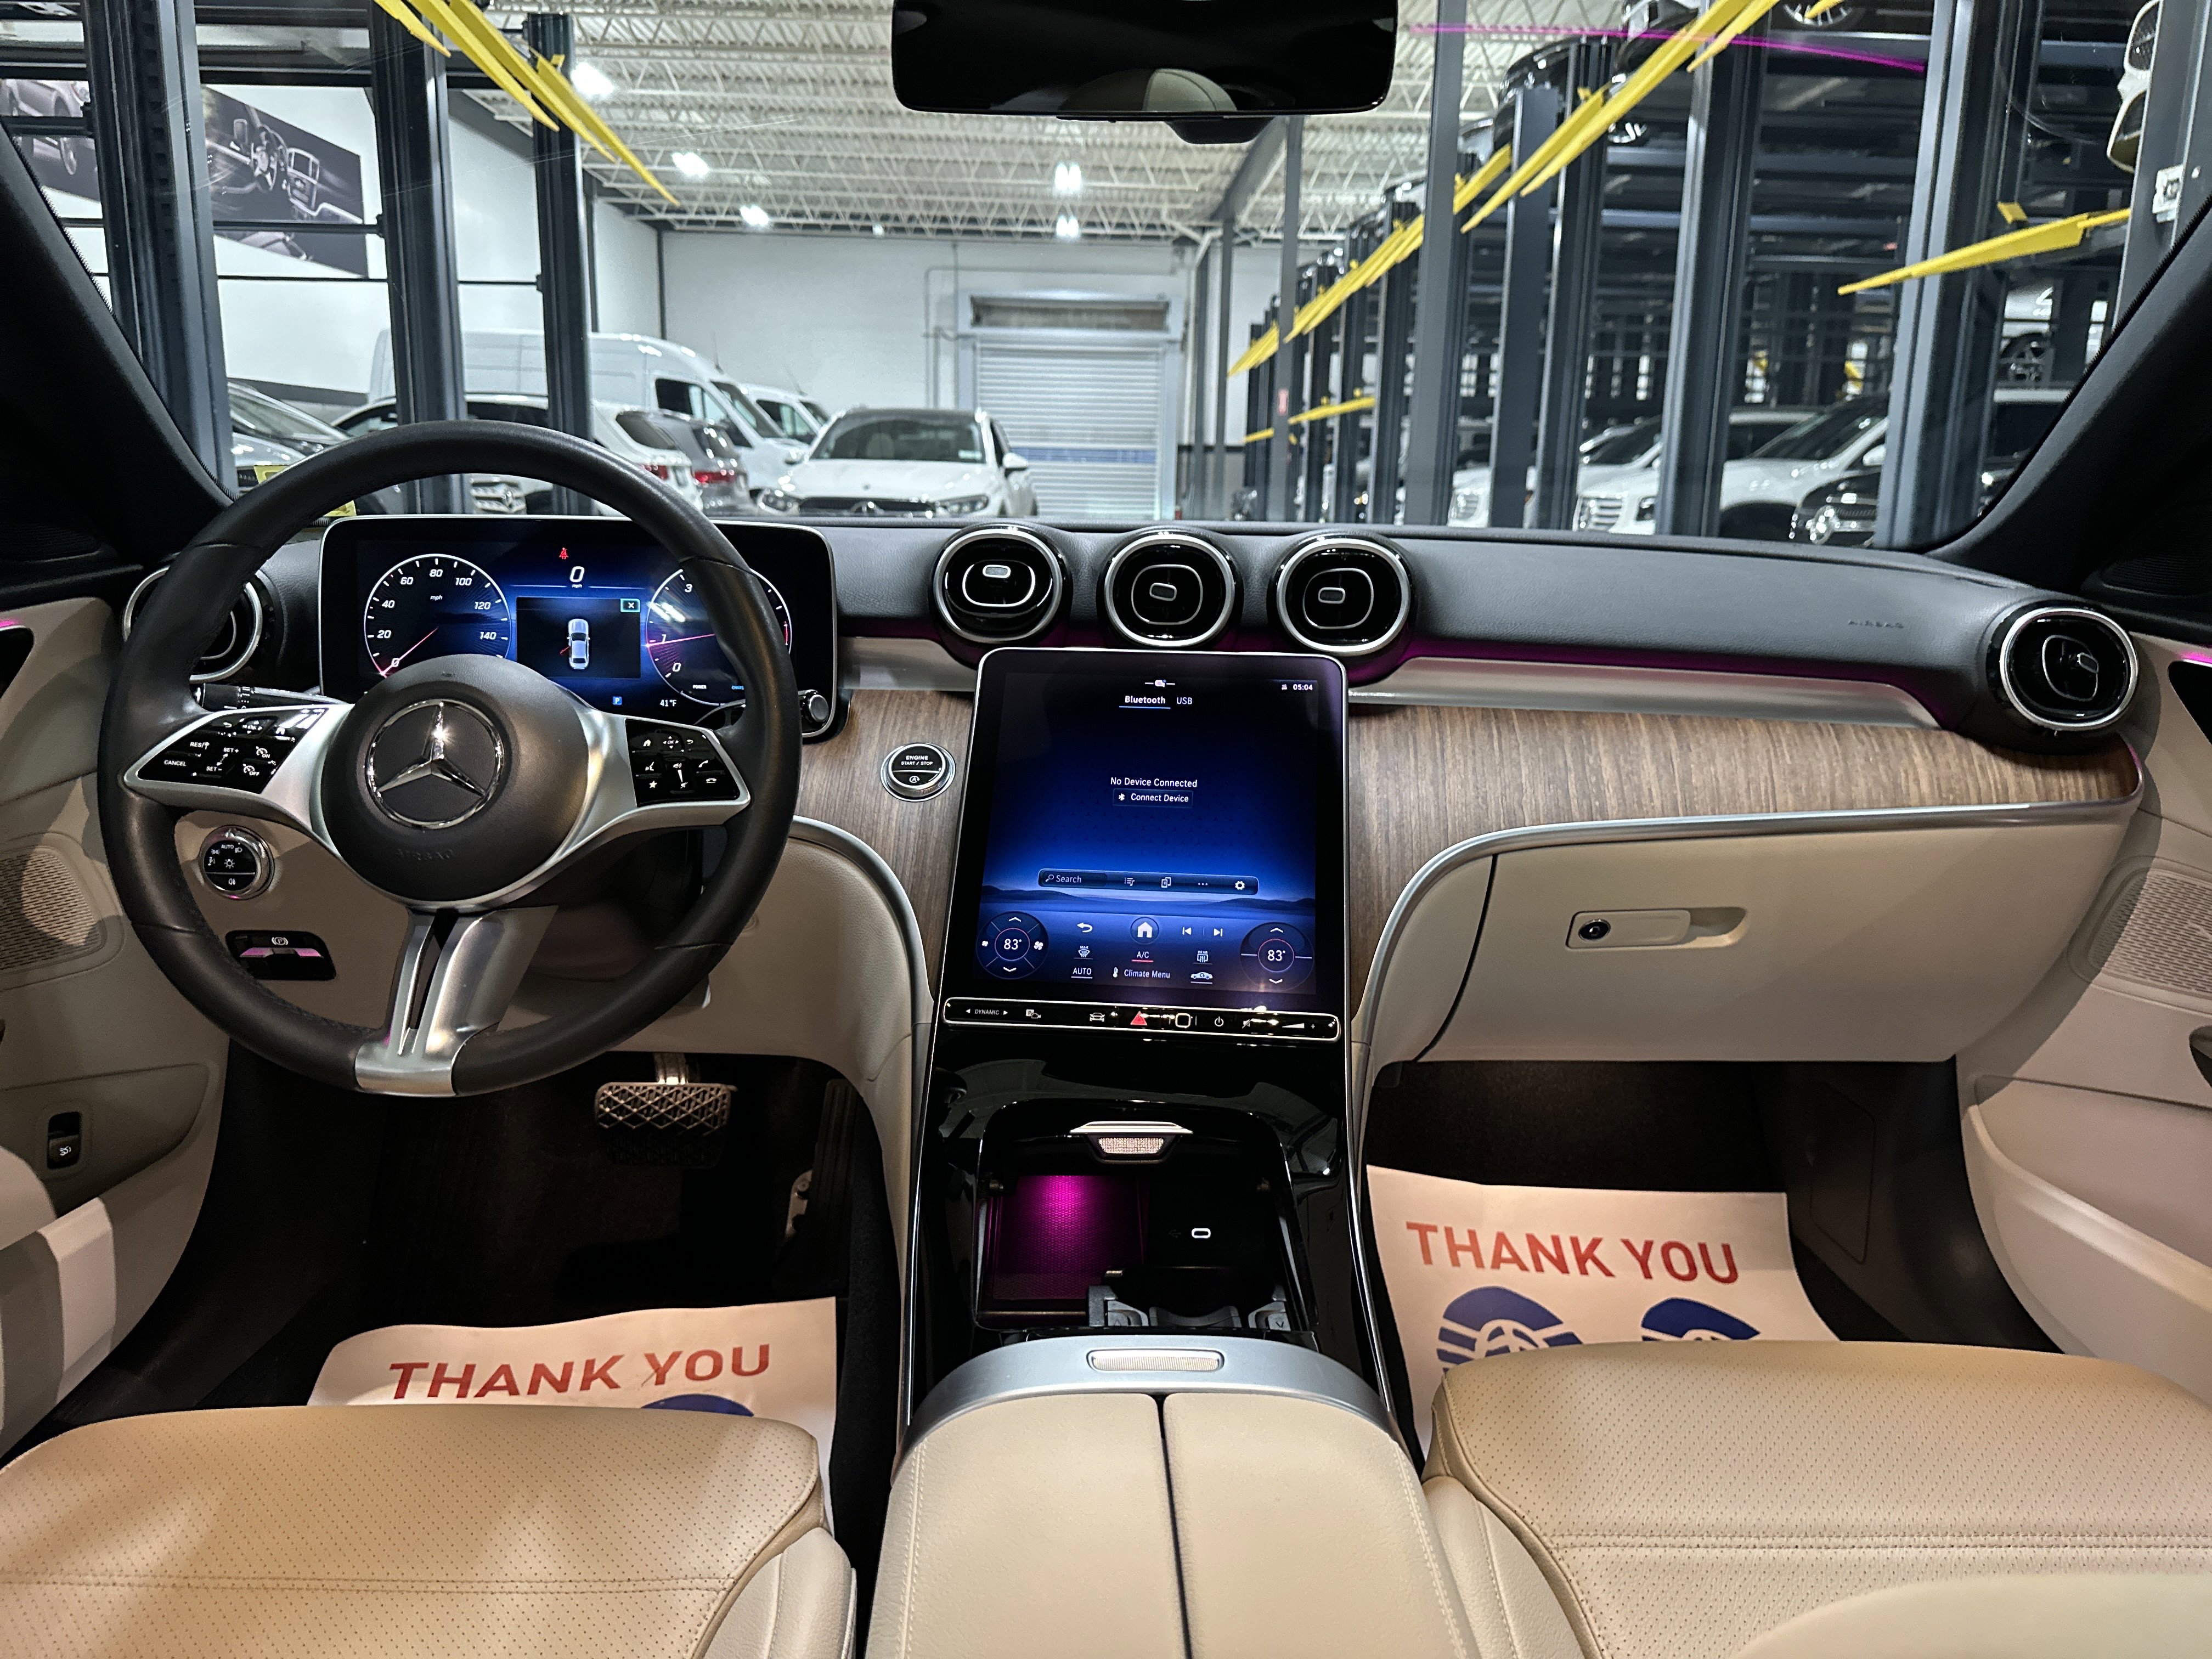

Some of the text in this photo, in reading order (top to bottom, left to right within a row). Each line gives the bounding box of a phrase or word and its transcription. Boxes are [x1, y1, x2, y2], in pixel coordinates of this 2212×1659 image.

[429, 569, 443, 577] 80
[569, 566, 585, 583] 0
[455, 577, 472, 586] 100
[685, 584, 693, 592] 3
[381, 600, 395, 608] 40
[475, 601, 491, 610] 120
[377, 630, 391, 639] 20
[479, 631, 496, 640] 140
[672, 662, 681, 672] 0
[1125, 696, 1193, 705] Bluetooth USB
[1110, 777, 1198, 788] No Device Connected
[1131, 793, 1162, 802] Connect
[1056, 874, 1082, 884] Search
[1003, 939, 1022, 950] 83°
[1267, 950, 1286, 962] 83°
[1124, 969, 1149, 978] Climate
[1406, 1221, 1739, 1284] THANK YOU
[390, 1344, 770, 1400] THANK YOU
